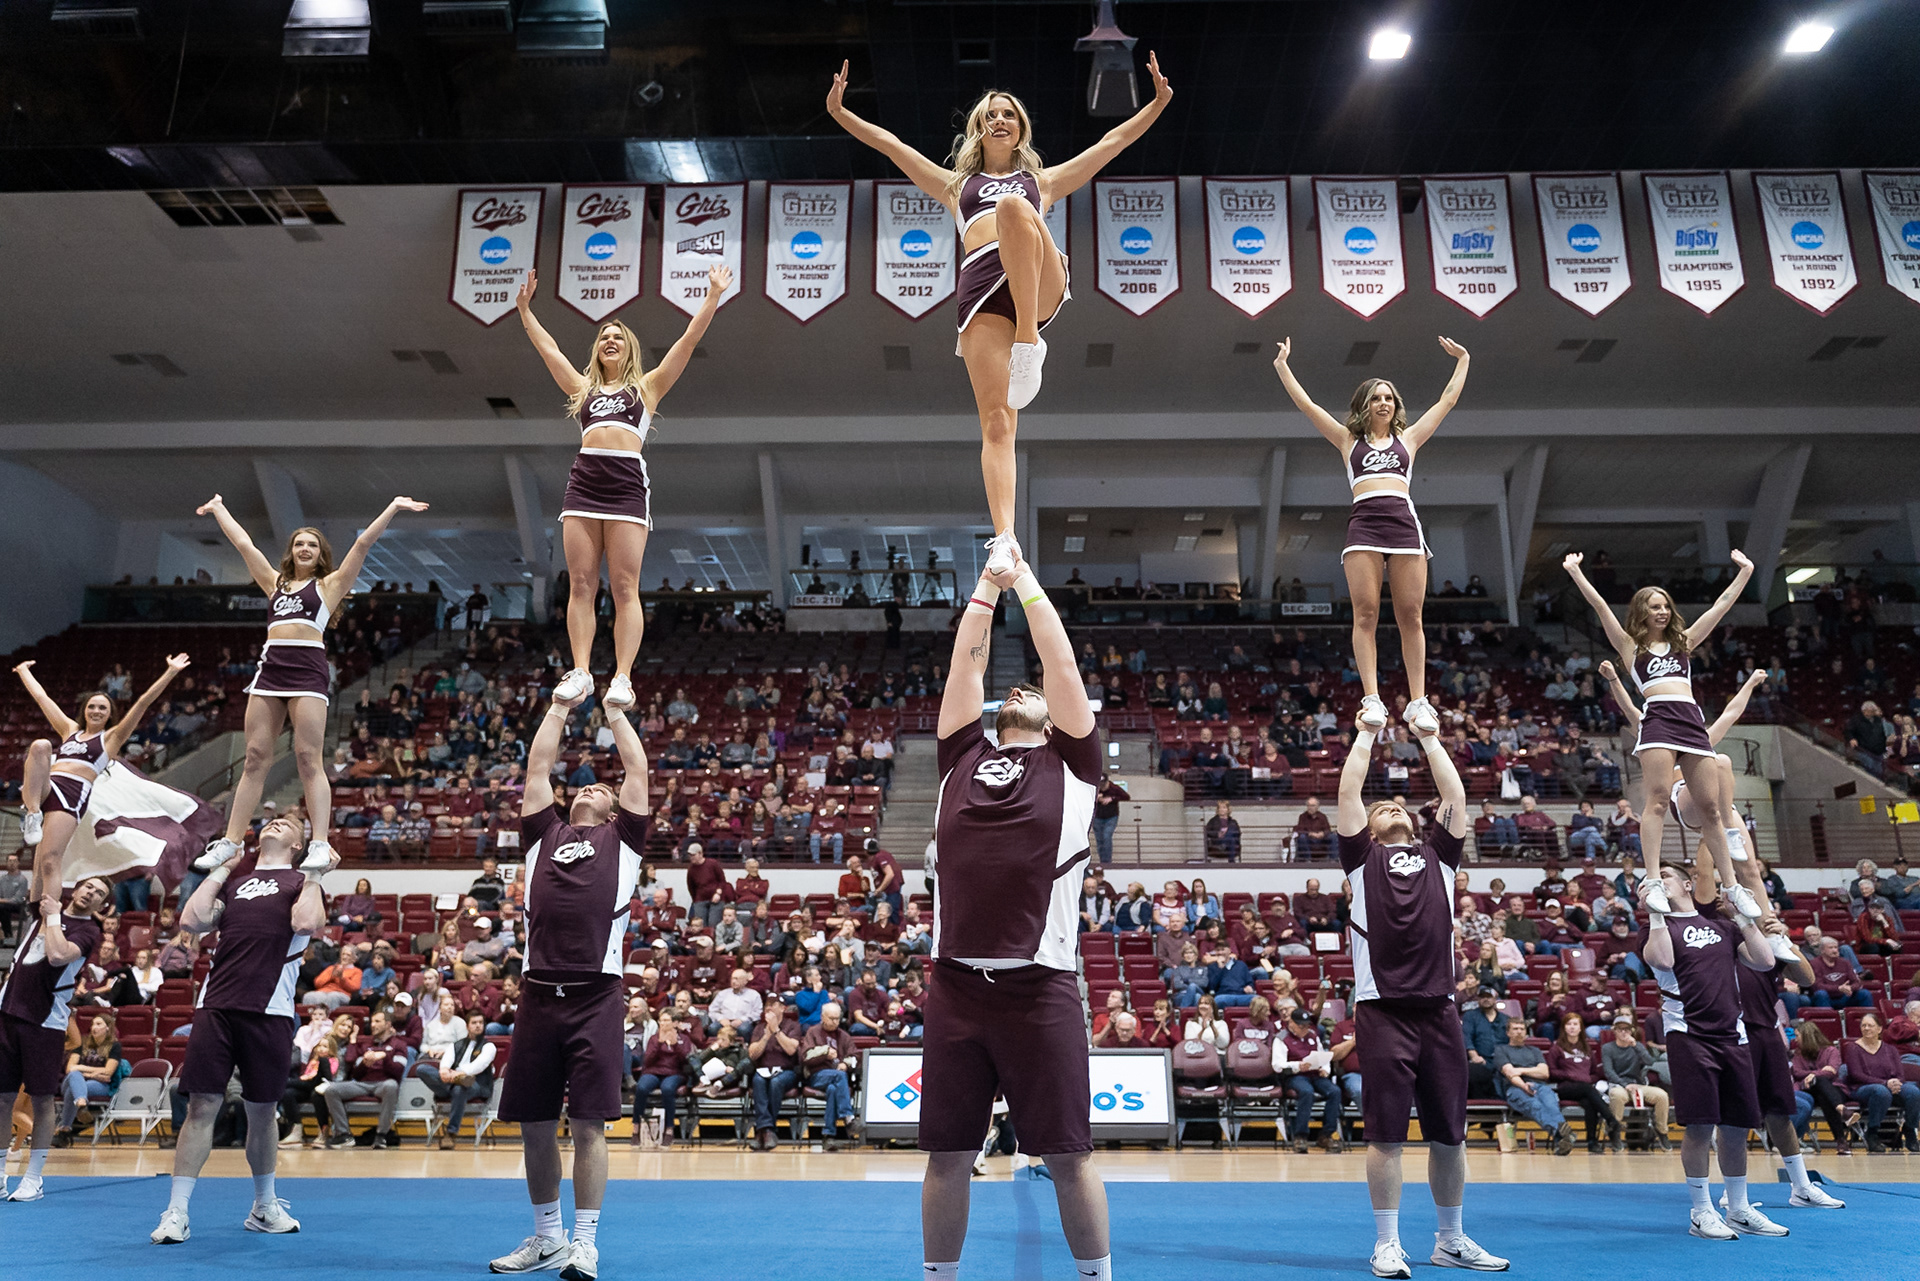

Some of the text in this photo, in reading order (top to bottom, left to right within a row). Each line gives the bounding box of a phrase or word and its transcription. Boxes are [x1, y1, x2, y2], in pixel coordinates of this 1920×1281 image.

[1440, 193, 1496, 211] GRIZ
[1551, 190, 1608, 208] GRIZ
[1661, 189, 1719, 207] GRIZ
[1772, 188, 1830, 206] GRIZ
[783, 198, 836, 216] GRIZ
[891, 197, 944, 215] GRIZ
[1109, 194, 1164, 212] GRIZ
[1221, 194, 1275, 212] GRIZ
[1330, 194, 1386, 212] GRIZ
[472, 198, 527, 231] Griz
[577, 193, 631, 227] Griz
[676, 192, 731, 227] Griz
[1123, 239, 1152, 248] NCAA
[1235, 239, 1265, 248] NCAA
[1347, 239, 1377, 248] NCAA
[1571, 236, 1600, 246] NCAA
[1794, 233, 1824, 244] NCAA
[793, 243, 822, 253] NCAA
[902, 242, 931, 252] NCAA
[1332, 259, 1394, 267] TOURNAMENT
[1668, 262, 1733, 272] CHAMPIONS
[463, 268, 524, 276] TOURNAMENT
[1443, 266, 1507, 275] CHAMPIONS
[1120, 282, 1157, 294] 2006
[1233, 282, 1270, 294] 2005
[1347, 283, 1384, 294] 2002
[1458, 283, 1497, 294] 2000
[1574, 282, 1608, 293] 1997
[1686, 280, 1722, 291] 1995
[1800, 279, 1836, 290] 1992
[581, 288, 615, 300] 2018
[684, 287, 708, 298] 201
[788, 288, 822, 299] 2013
[899, 286, 932, 297] 2012
[474, 292, 508, 303] 2019
[589, 396, 626, 417] Griz
[1362, 450, 1400, 471] Griz
[273, 595, 304, 616] Griz
[1647, 657, 1682, 678] Griz
[1683, 925, 1722, 949] Griz
